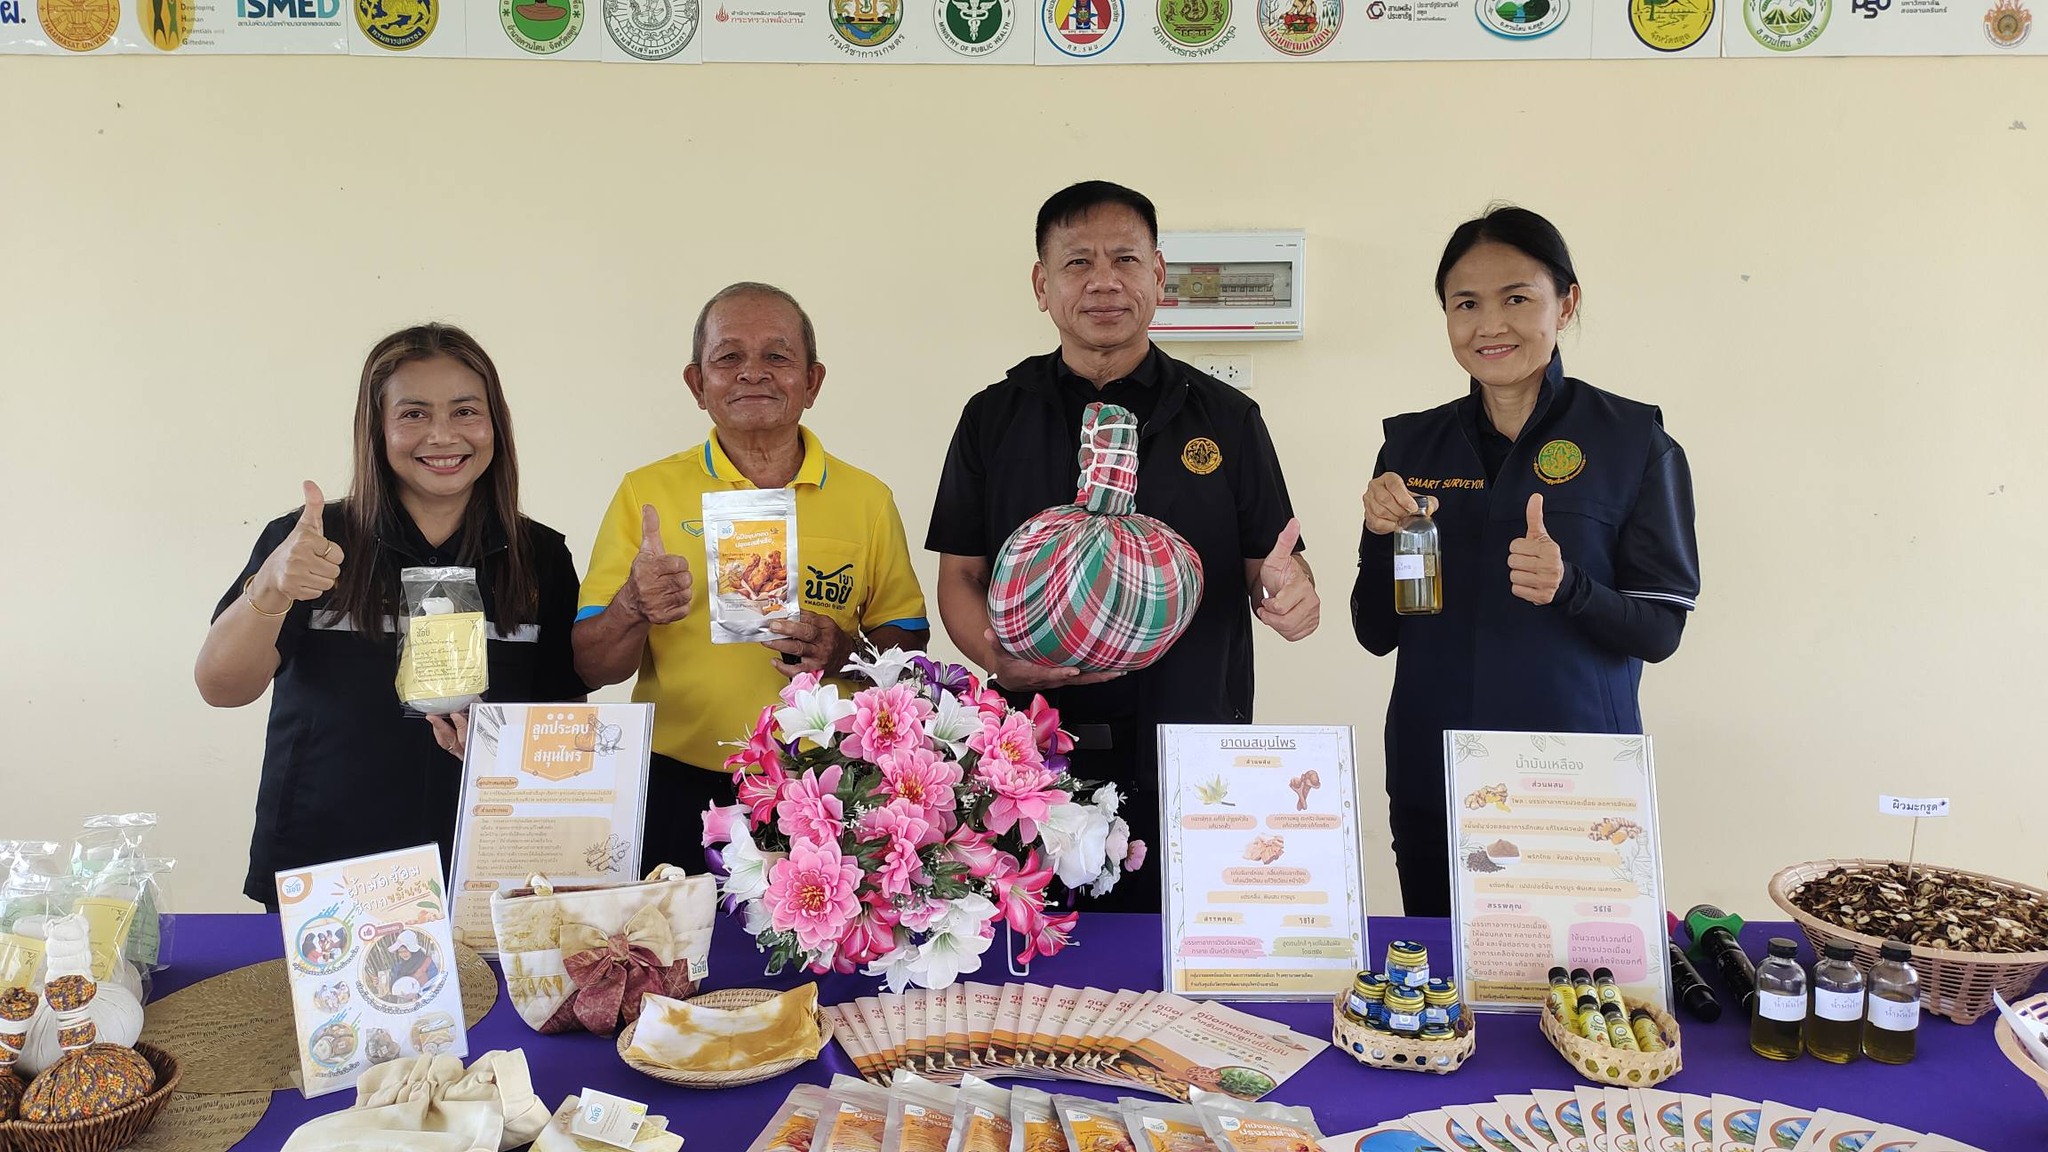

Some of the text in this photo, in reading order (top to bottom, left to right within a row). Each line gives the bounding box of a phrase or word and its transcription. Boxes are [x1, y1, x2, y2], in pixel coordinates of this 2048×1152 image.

[181, 3, 215, 16] Developing
[237, 0, 340, 18] ISMED
[1387, 11, 1413, 21] ประชารัฐ
[731, 15, 804, 24] กระทรวงพลังงาน
[42, 19, 116, 49] THAMMASAT UNIVERSITY
[181, 27, 212, 35] Potentials
[938, 21, 960, 48] MINISTRY
[971, 43, 994, 53] PUBLIC
[993, 21, 1012, 45] HEALTH
[181, 38, 215, 46] Giftedness
[827, 33, 906, 59] กรมวิชาการเกษตร
[1407, 477, 1484, 490] SMART SURVEYOR
[805, 564, 854, 604] น้อย
[533, 721, 590, 741] ลูกประคบ
[1220, 736, 1296, 750] ยาดมสมุนไพร
[534, 745, 582, 767] สมุนไพร
[1516, 754, 1584, 770] น้ำมันเหลือง
[1892, 799, 1938, 815] ผิวมะกรูด
[347, 864, 423, 899] ผ้ามัดย้อม
[1488, 903, 1522, 911] สรรพคุณ
[1472, 920, 1547, 929] บรรเทาอาการปวดเมื่อย
[1572, 945, 1631, 954] อาการปวดเมื่อย
[1197, 1010, 1265, 1041] คู่มือเกษตรกร
